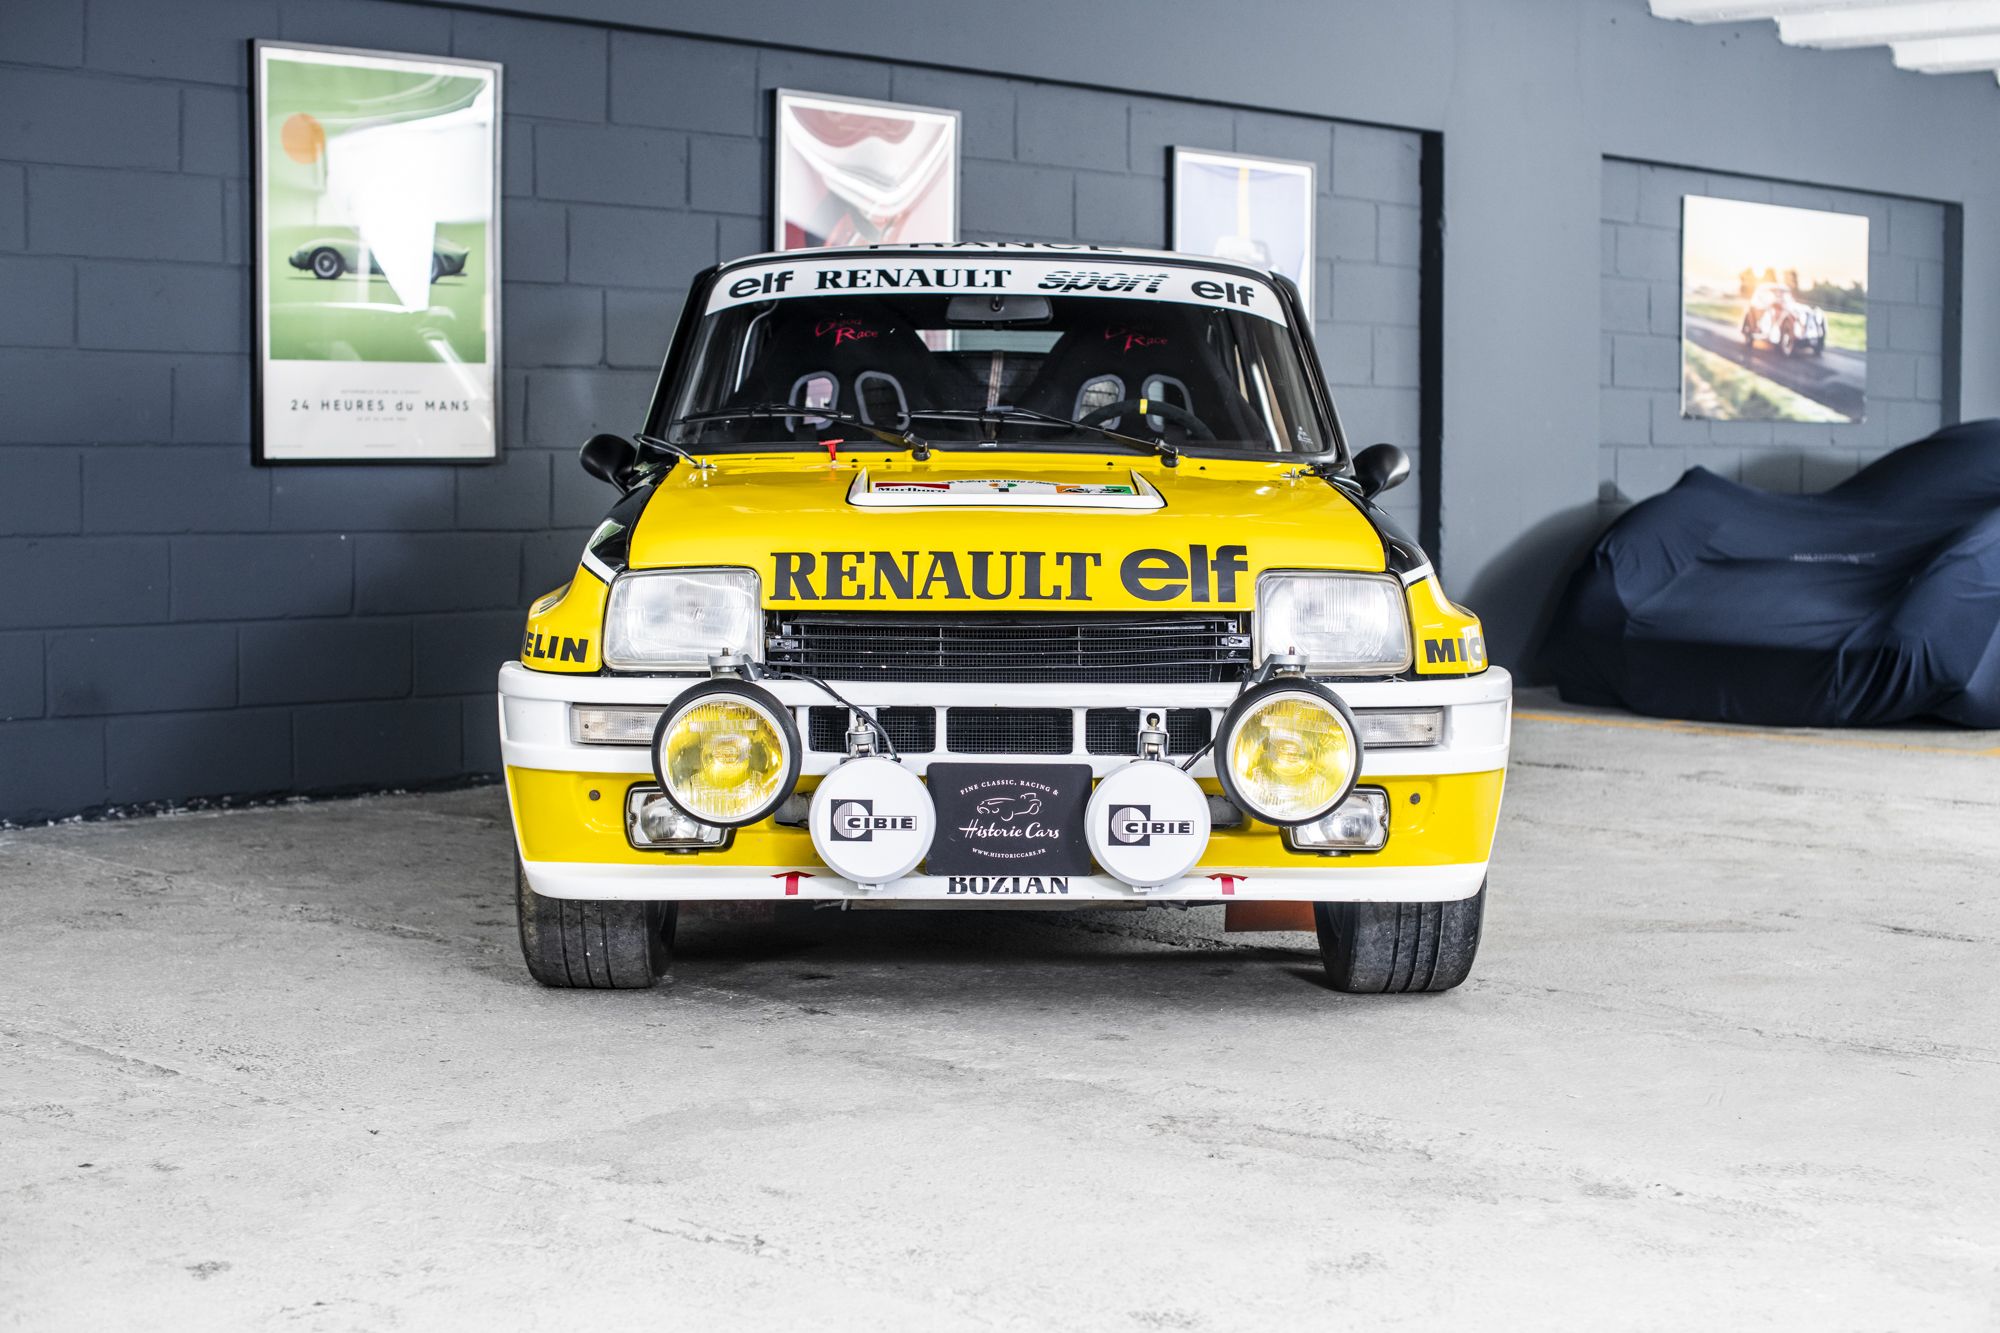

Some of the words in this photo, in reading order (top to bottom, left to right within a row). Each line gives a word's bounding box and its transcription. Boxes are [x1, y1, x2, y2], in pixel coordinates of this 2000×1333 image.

[729, 270, 794, 298] elf
[814, 268, 1012, 290] RENAULT
[1038, 270, 1171, 294] sport
[1191, 280, 1255, 307] elf
[290, 400, 310, 411] 24
[320, 399, 385, 412] HEURES
[395, 400, 414, 412] du
[425, 400, 470, 412] MANS
[769, 551, 1101, 600] RENAULT
[1120, 544, 1248, 603] elf
[1424, 637, 1487, 663] MIC
[981, 779, 1017, 788] CLASSIC,
[1020, 780, 1051, 793] RACING
[1052, 788, 1059, 796] &
[958, 818, 1024, 839] Historic
[1025, 821, 1060, 839] Cars
[946, 876, 1070, 895] BOZIAN
